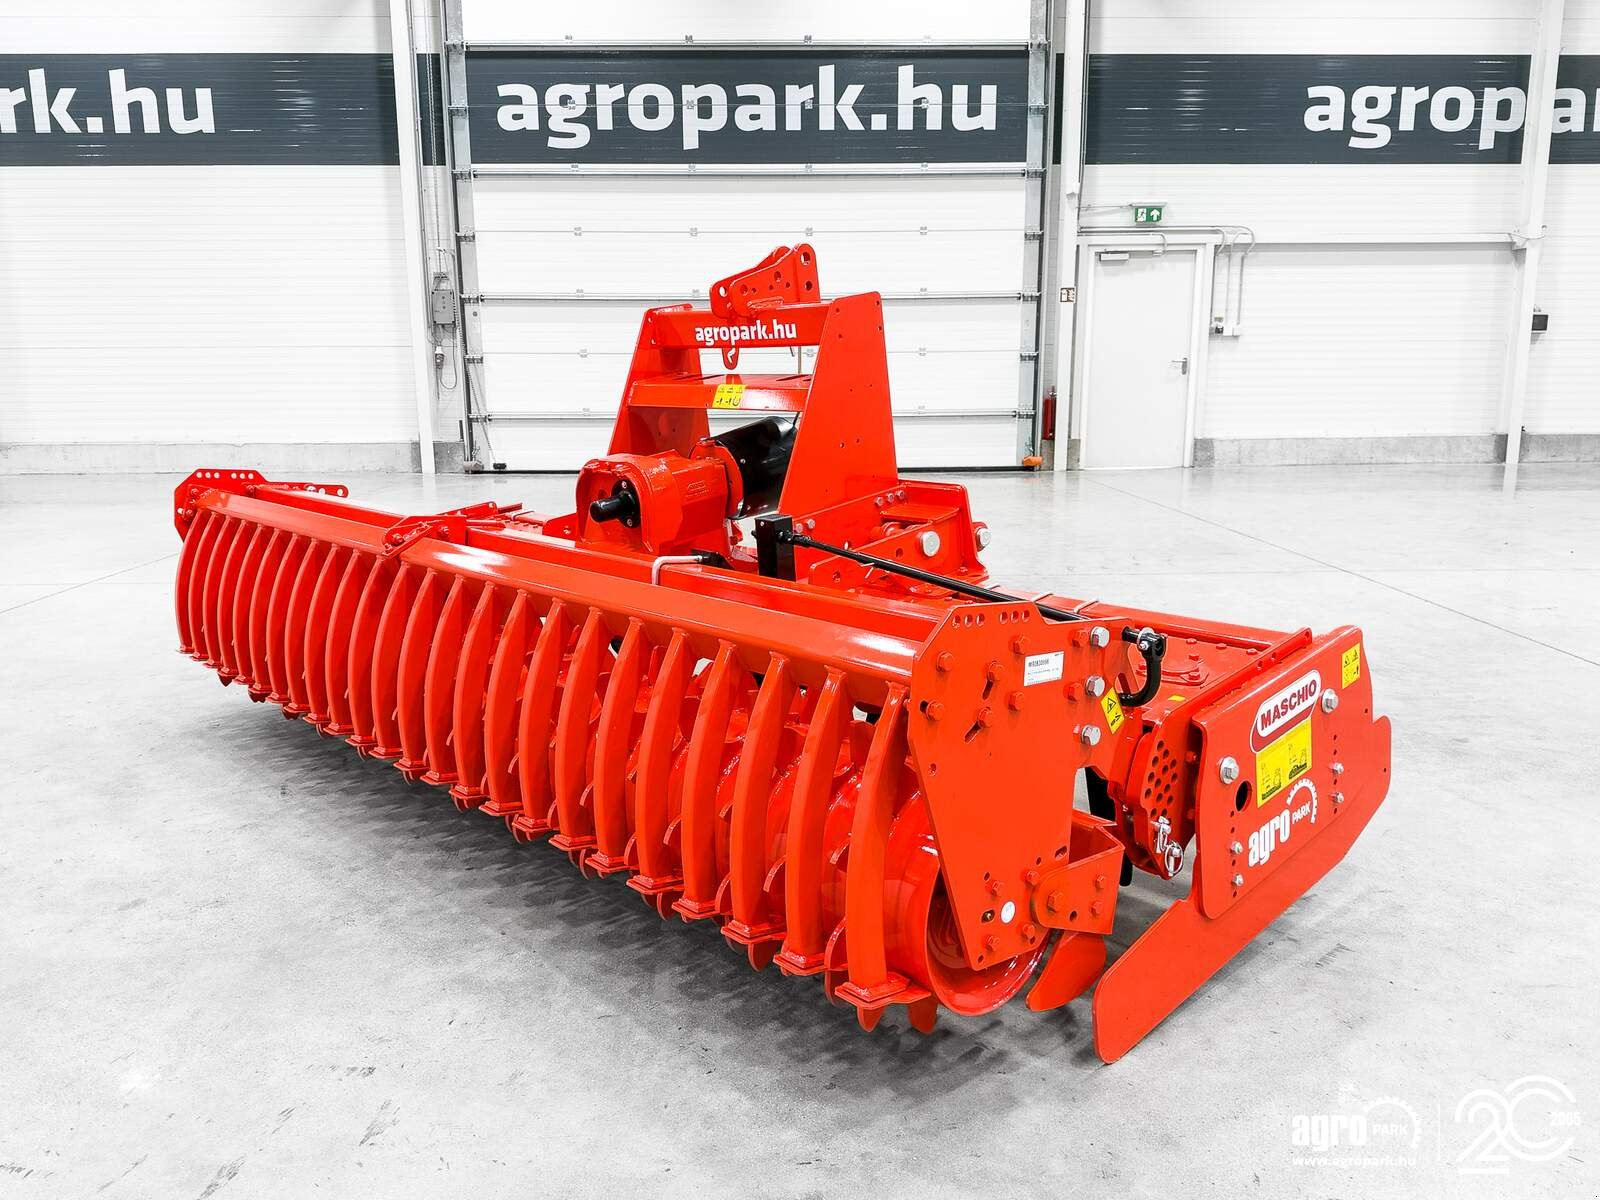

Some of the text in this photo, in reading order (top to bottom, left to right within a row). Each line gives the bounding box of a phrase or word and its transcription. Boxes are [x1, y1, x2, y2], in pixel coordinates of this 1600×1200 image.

[496, 64, 998, 151] agropark.hu
[1303, 85, 1600, 150] agropa
[694, 319, 798, 346] agropark.hu
[1260, 678, 1318, 731] MASCHIO
[1248, 804, 1311, 867] agro PARK
